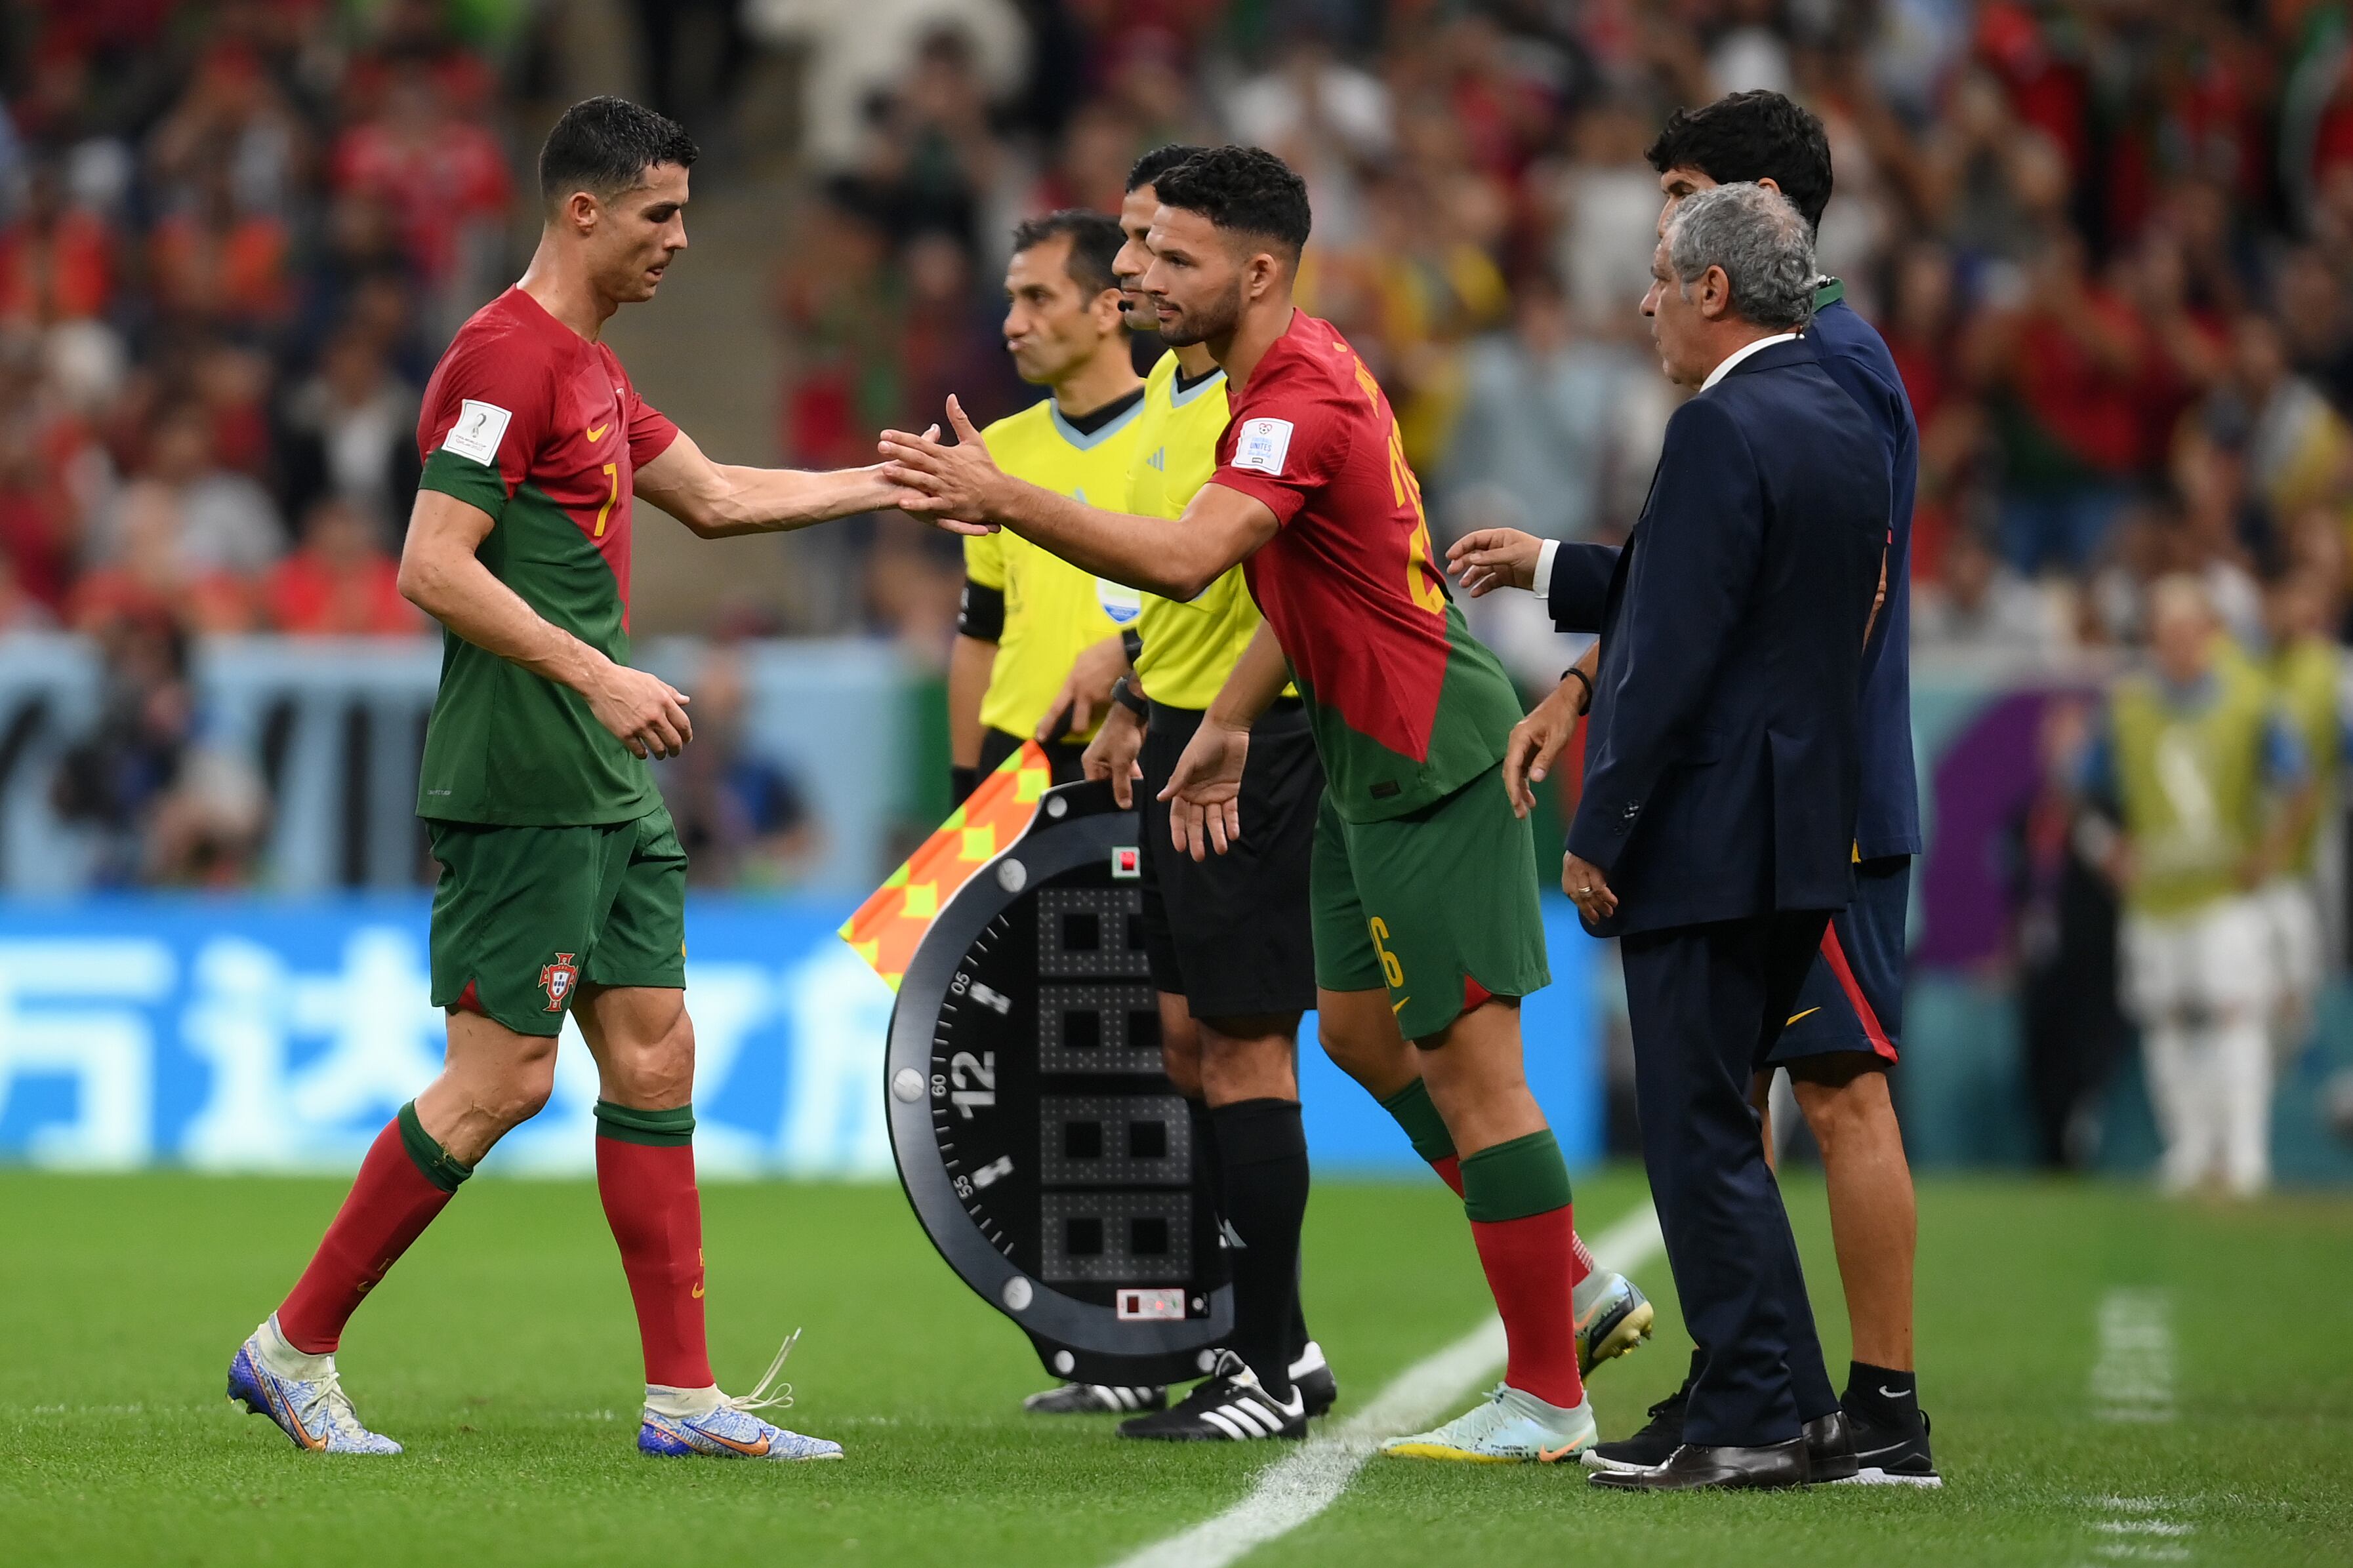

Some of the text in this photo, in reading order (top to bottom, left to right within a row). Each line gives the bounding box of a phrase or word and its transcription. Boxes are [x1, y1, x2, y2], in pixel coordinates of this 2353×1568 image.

[1250, 442, 1272, 452] UNITES
[594, 462, 618, 536] 7
[931, 1074, 947, 1098] 60
[951, 1051, 996, 1119] 12
[952, 1175, 973, 1199] 55
